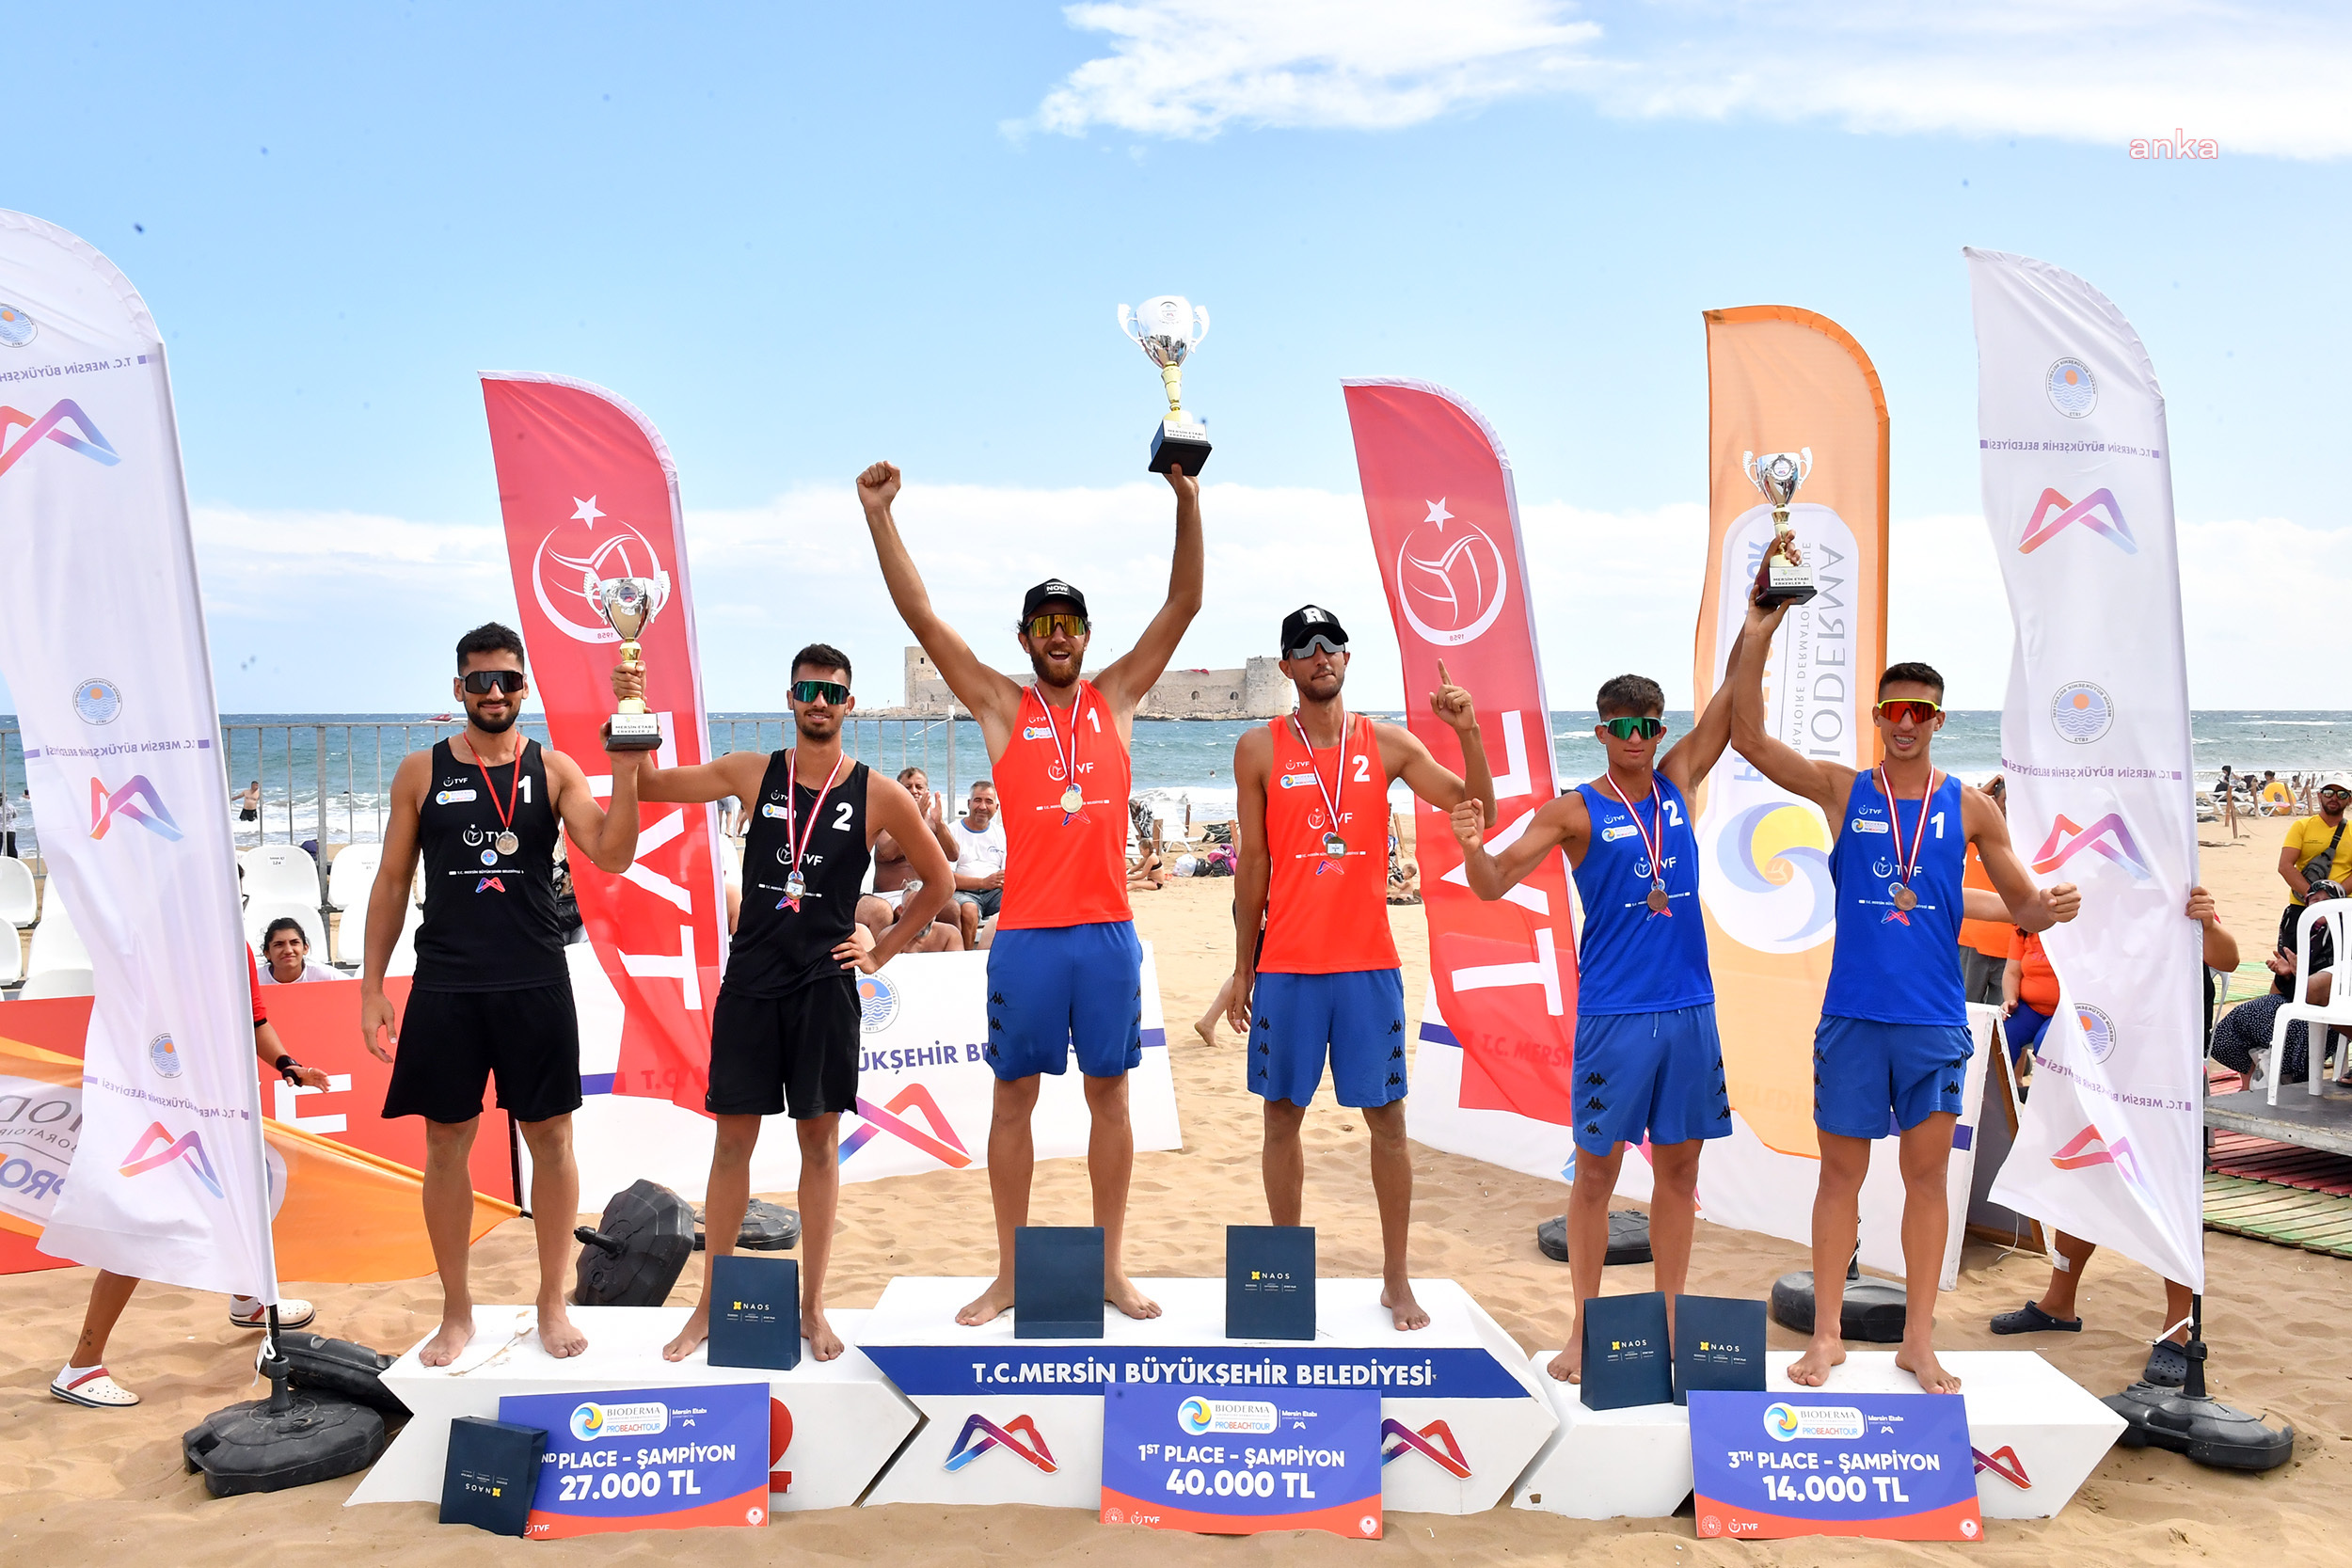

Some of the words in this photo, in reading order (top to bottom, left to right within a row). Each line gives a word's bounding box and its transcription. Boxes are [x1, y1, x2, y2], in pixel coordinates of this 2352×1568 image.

[1087, 707, 1102, 733] 1
[1352, 754, 1371, 782] 2
[517, 775, 532, 803] 1
[832, 802, 853, 832] 2
[1662, 800, 1683, 827] 2
[1931, 811, 1945, 839] 1
[743, 1303, 770, 1311] NAOS
[1621, 1339, 1647, 1348] NAOS
[1710, 1343, 1740, 1353] NAOS
[1124, 1356, 1287, 1386] BÜYÜKŞEHİR
[1295, 1358, 1433, 1386] BELEDİYESİ
[607, 1407, 660, 1417] BIODERMA
[1215, 1404, 1270, 1414] BIODERMA
[1801, 1410, 1856, 1419] BIODERMA
[606, 1423, 660, 1433] PROBEACHTOUR
[1215, 1421, 1270, 1431] PROBEACHTOUR
[1802, 1427, 1858, 1435] PROBEACHTOUR
[559, 1450, 617, 1470] PLACE
[637, 1442, 736, 1470] ŞAMPİYON
[1164, 1446, 1224, 1465] PLACE
[1244, 1444, 1345, 1469] ŞAMPİYON
[1727, 1450, 1753, 1469] 3TH
[1757, 1451, 1819, 1469] PLACE
[1838, 1449, 1940, 1474] ŞAMPİYON
[465, 1482, 490, 1494] NAOS
[559, 1471, 660, 1501] 27.000
[668, 1470, 701, 1496] TL
[1166, 1468, 1275, 1497] 40.000
[1281, 1471, 1315, 1499] TL
[1762, 1475, 1867, 1502] 14.000
[1872, 1476, 1910, 1503] TL
[533, 1524, 549, 1532] TVF
[1143, 1515, 1160, 1524] TVF
[1741, 1522, 1758, 1531] TVF
